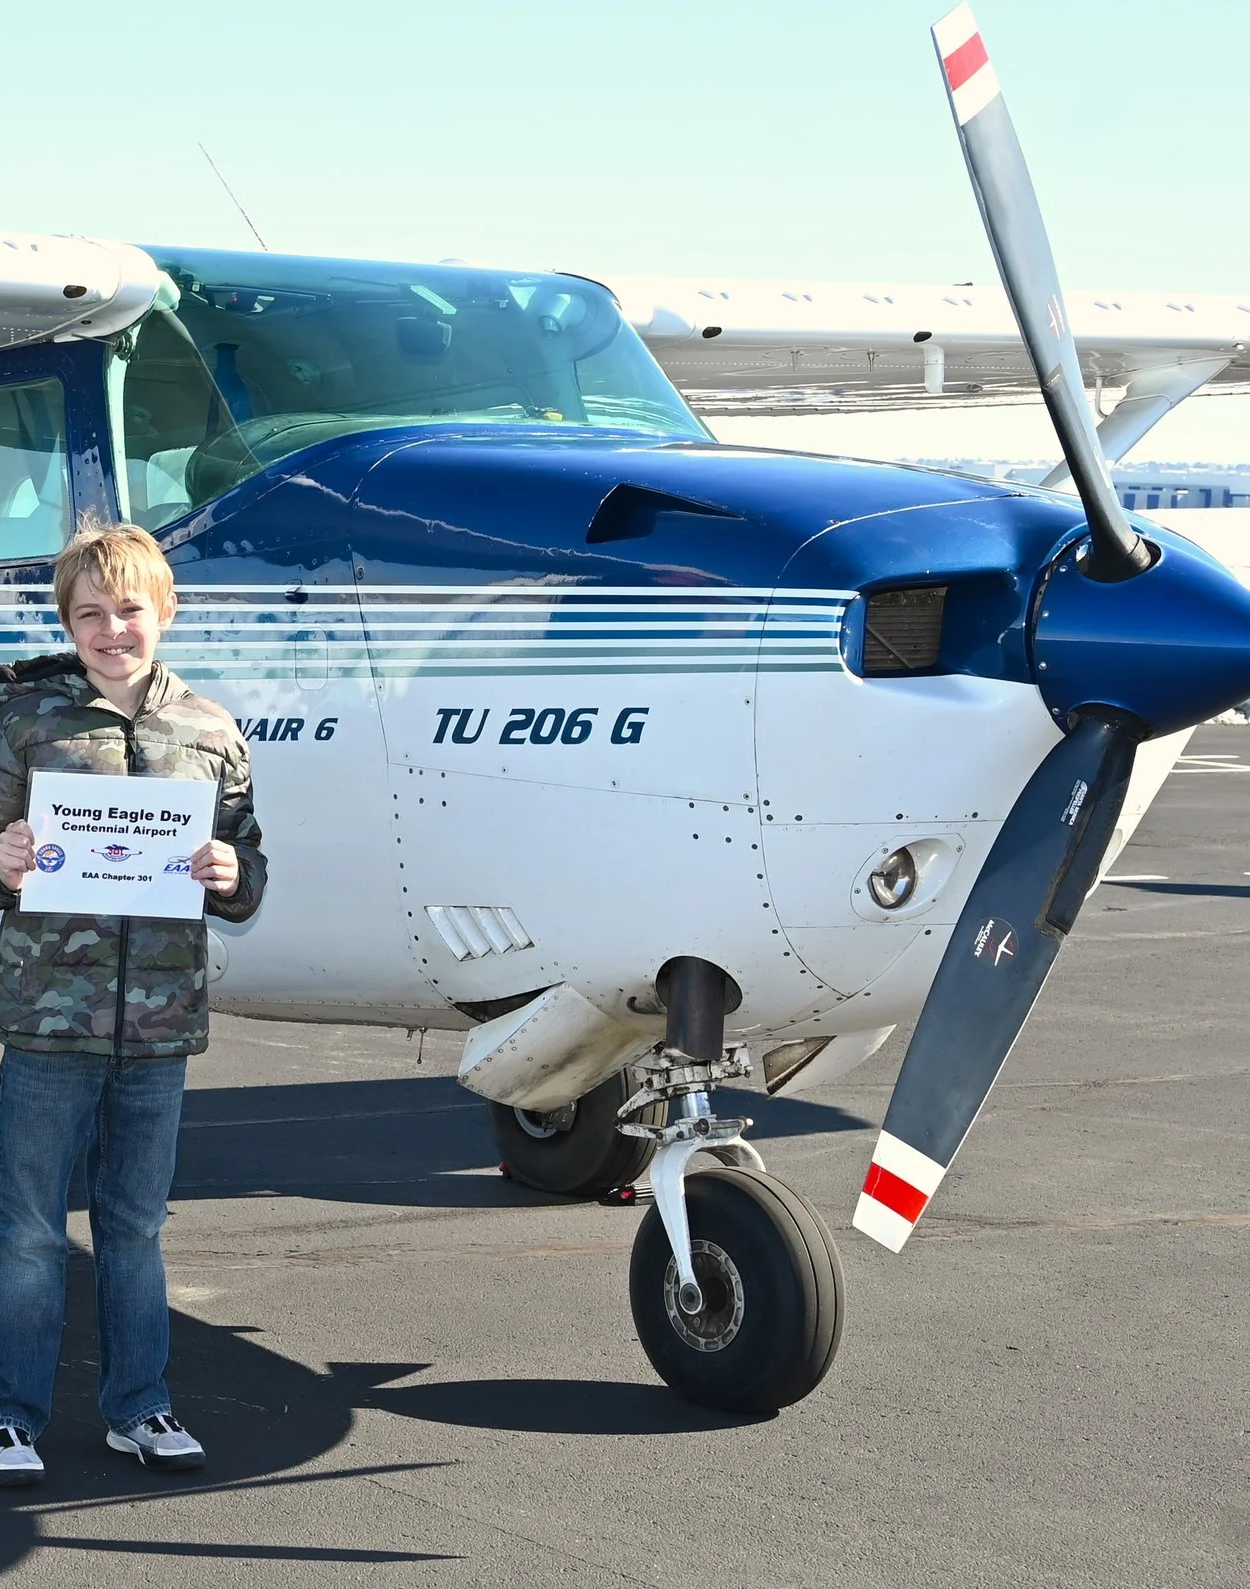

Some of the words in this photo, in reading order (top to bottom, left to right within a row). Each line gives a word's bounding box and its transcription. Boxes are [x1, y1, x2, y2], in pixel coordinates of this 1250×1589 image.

[314, 717, 338, 741] 6
[433, 708, 490, 744] TU
[498, 707, 599, 745] 206
[610, 707, 649, 744] G
[52, 804, 102, 821] Young
[108, 807, 155, 823] Eagle
[160, 810, 192, 826] Day
[61, 822, 129, 834] Centennial
[133, 826, 177, 837] Airport
[163, 863, 191, 872] EAA
[82, 872, 100, 880] EAA
[102, 873, 136, 882] Chapter
[137, 874, 152, 882] 301
